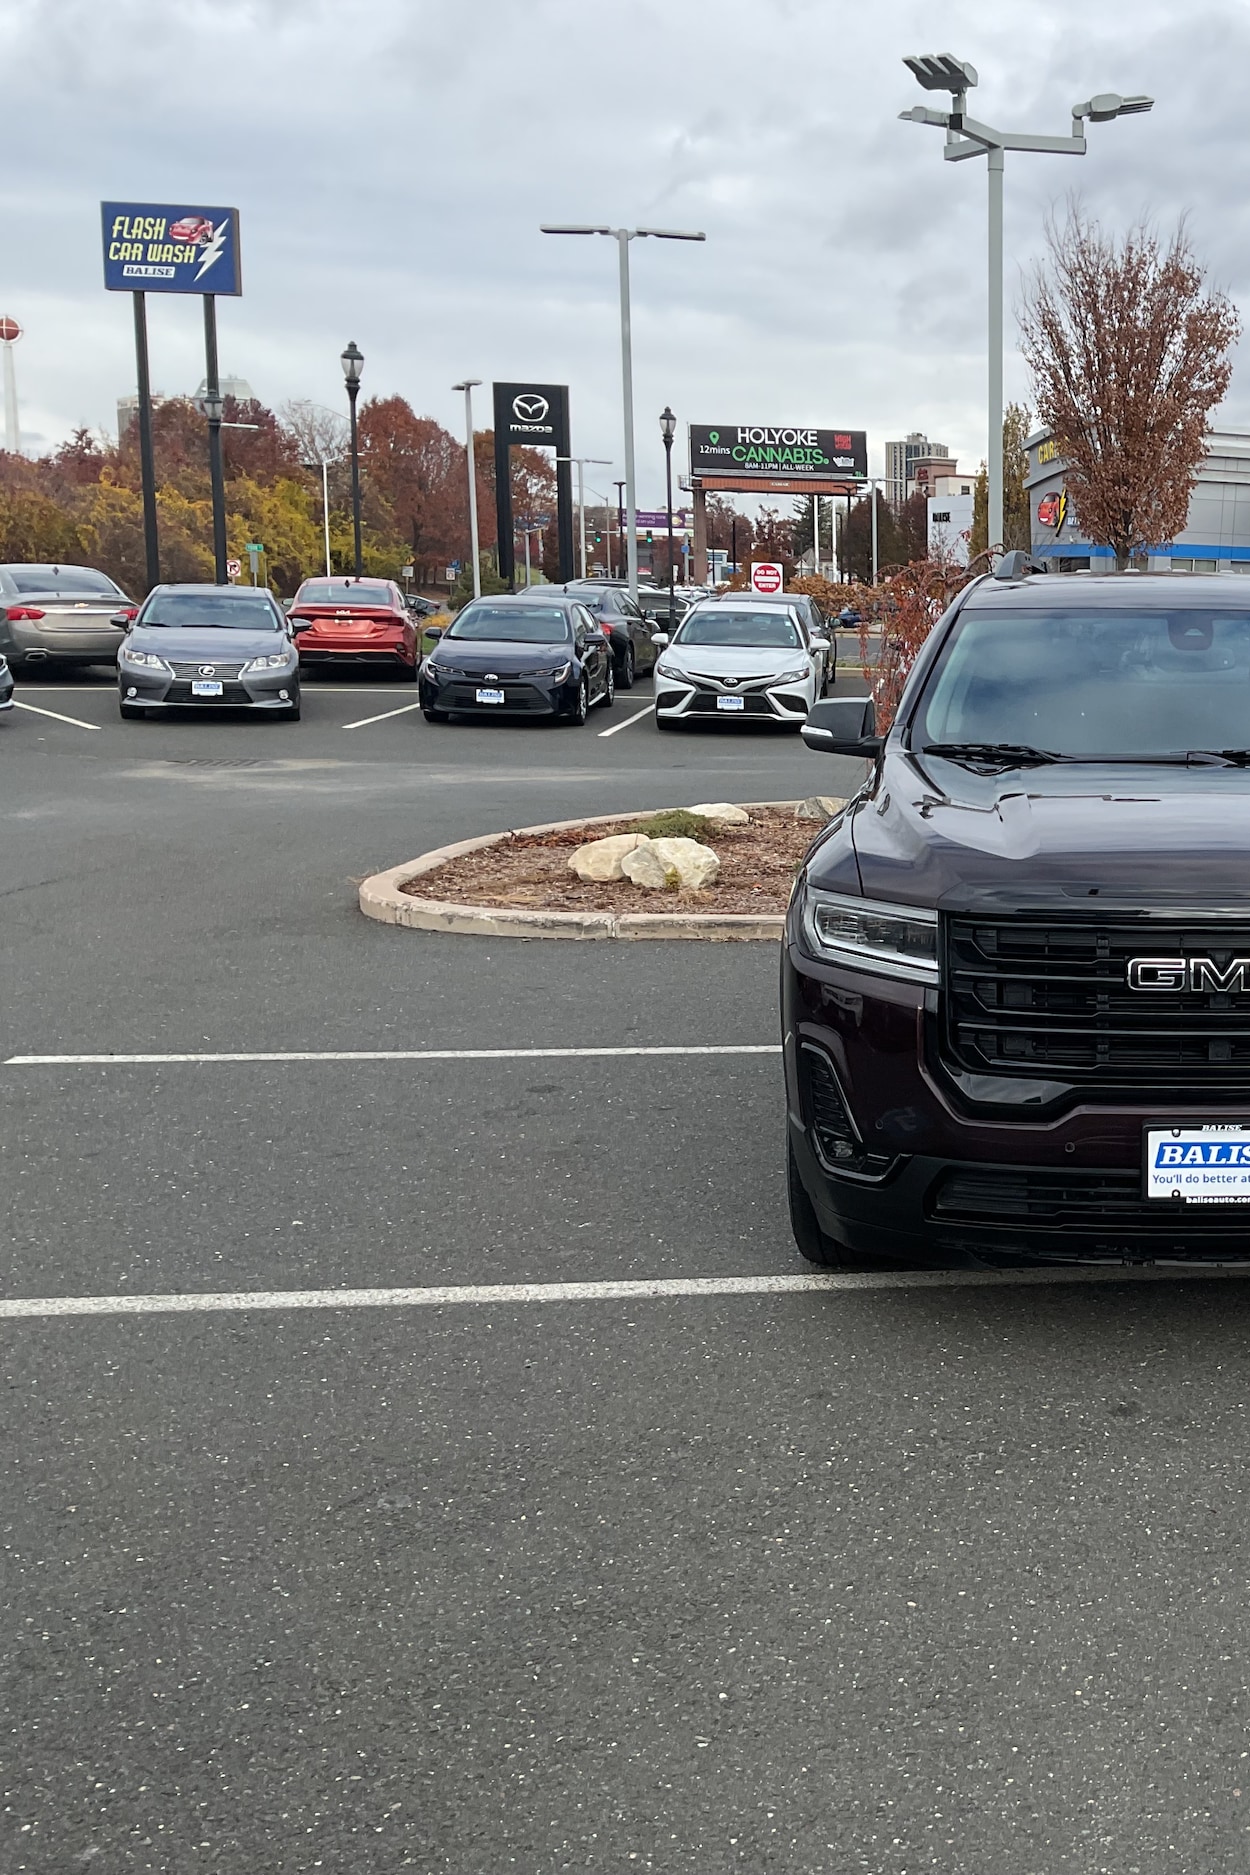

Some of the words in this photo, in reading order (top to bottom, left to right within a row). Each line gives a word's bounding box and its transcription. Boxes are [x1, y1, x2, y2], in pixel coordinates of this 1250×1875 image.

[112, 216, 166, 240] FLASH
[108, 242, 143, 261] CAR
[146, 244, 196, 263] WASH
[125, 266, 173, 276] BALISE
[510, 424, 552, 433] mazda
[737, 427, 818, 446] HOLYOKE
[700, 445, 730, 454] 12mins
[1038, 441, 1055, 464] CAR
[1153, 1174, 1182, 1183] You'll
[1186, 1174, 1199, 1183] do
[1203, 1174, 1237, 1183] better
